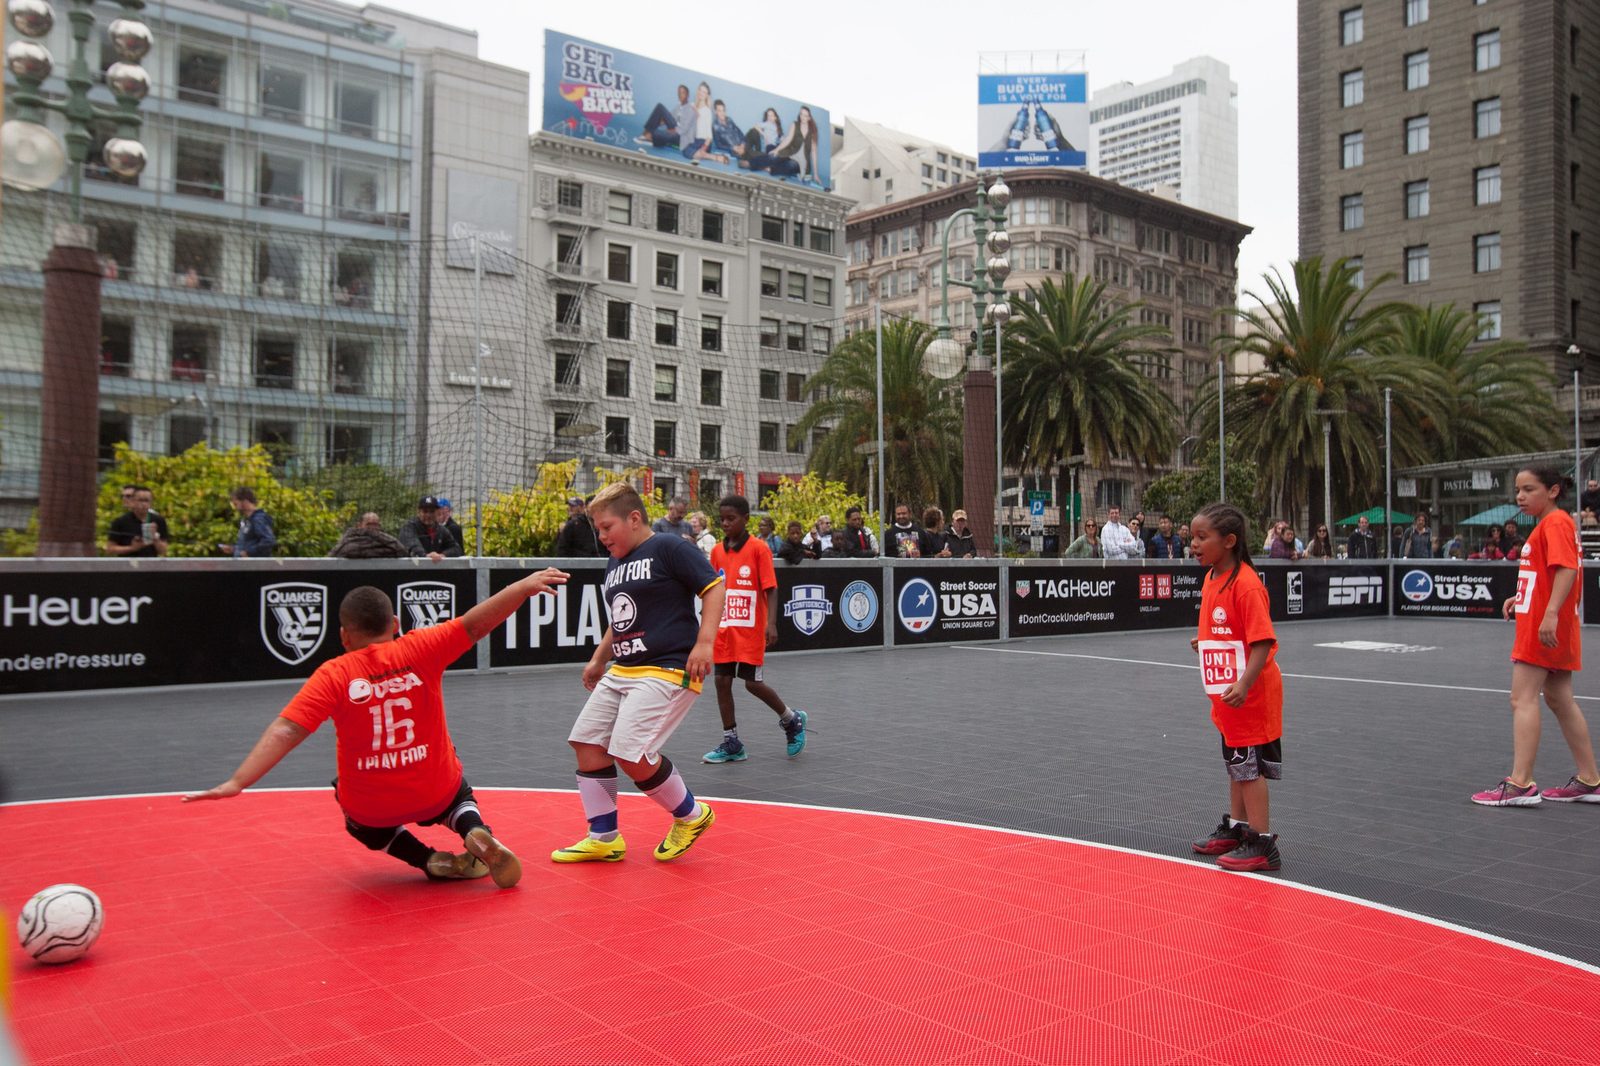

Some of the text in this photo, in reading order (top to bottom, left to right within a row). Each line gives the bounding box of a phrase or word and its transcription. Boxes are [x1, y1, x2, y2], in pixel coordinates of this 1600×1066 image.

[564, 42, 613, 68] GET
[564, 61, 632, 91] BACK
[588, 87, 633, 99] THROW
[997, 83, 1066, 94] BUD LIGHT
[582, 96, 636, 115] BACK
[626, 558, 653, 582] FOR
[1157, 577, 1169, 586] UNI
[1434, 575, 1493, 583] Street Soccer
[940, 581, 997, 591] Street Soccer
[1158, 586, 1170, 597] QLO
[1327, 576, 1383, 605] ESPN
[1433, 583, 1493, 601] USA
[266, 589, 322, 603] QUAKES
[402, 588, 450, 601] QUAKES
[1172, 588, 1191, 600] Simple
[729, 598, 748, 607] UNI
[792, 600, 826, 610] CONFIDENCE
[940, 593, 997, 617] USA
[1450, 605, 1467, 613] GOALS
[3, 594, 153, 627] Heuer
[729, 607, 749, 618] QLO
[961, 621, 983, 629] SQUARE
[983, 620, 995, 628] CUP
[1018, 612, 1115, 624] #DontCrackUnderPressure
[1211, 626, 1233, 635] USA
[612, 637, 648, 657] USA
[1204, 652, 1231, 666] UNI
[1206, 666, 1234, 683] QLO
[372, 672, 424, 698] USA
[368, 697, 415, 751] 16
[357, 757, 363, 770] I
[400, 745, 429, 766] FOR
